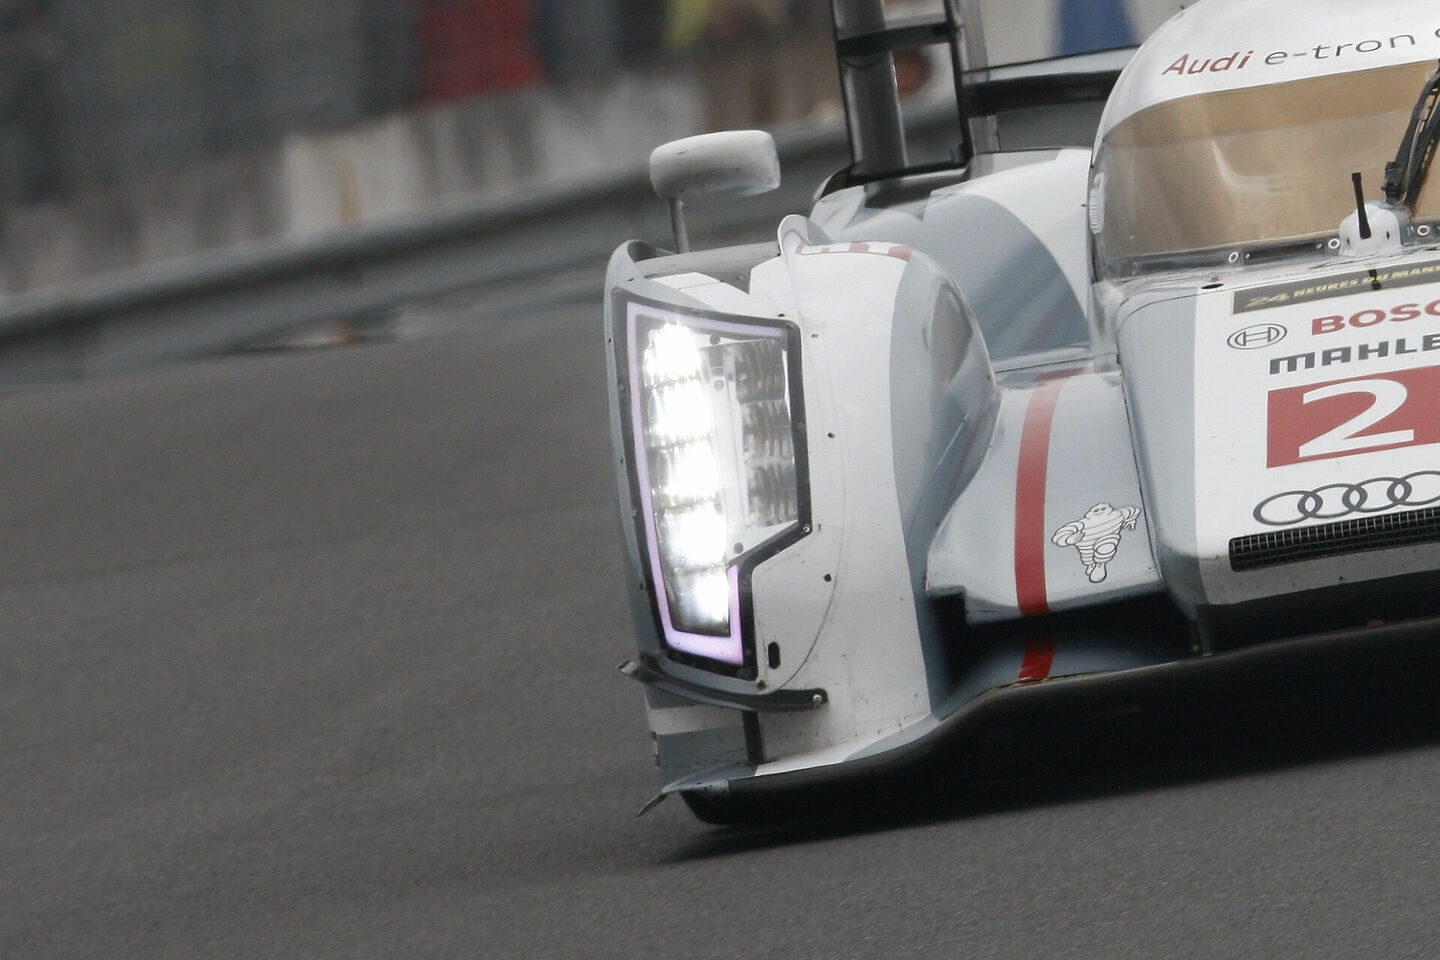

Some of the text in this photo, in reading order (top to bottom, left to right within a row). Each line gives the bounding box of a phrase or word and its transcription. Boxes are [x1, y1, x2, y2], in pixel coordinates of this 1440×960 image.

[1161, 51, 1254, 76] Audi
[1264, 34, 1417, 66] e-tron
[1244, 292, 1291, 309] 24
[1293, 278, 1360, 298] HEURES
[1298, 378, 1415, 460] 2
